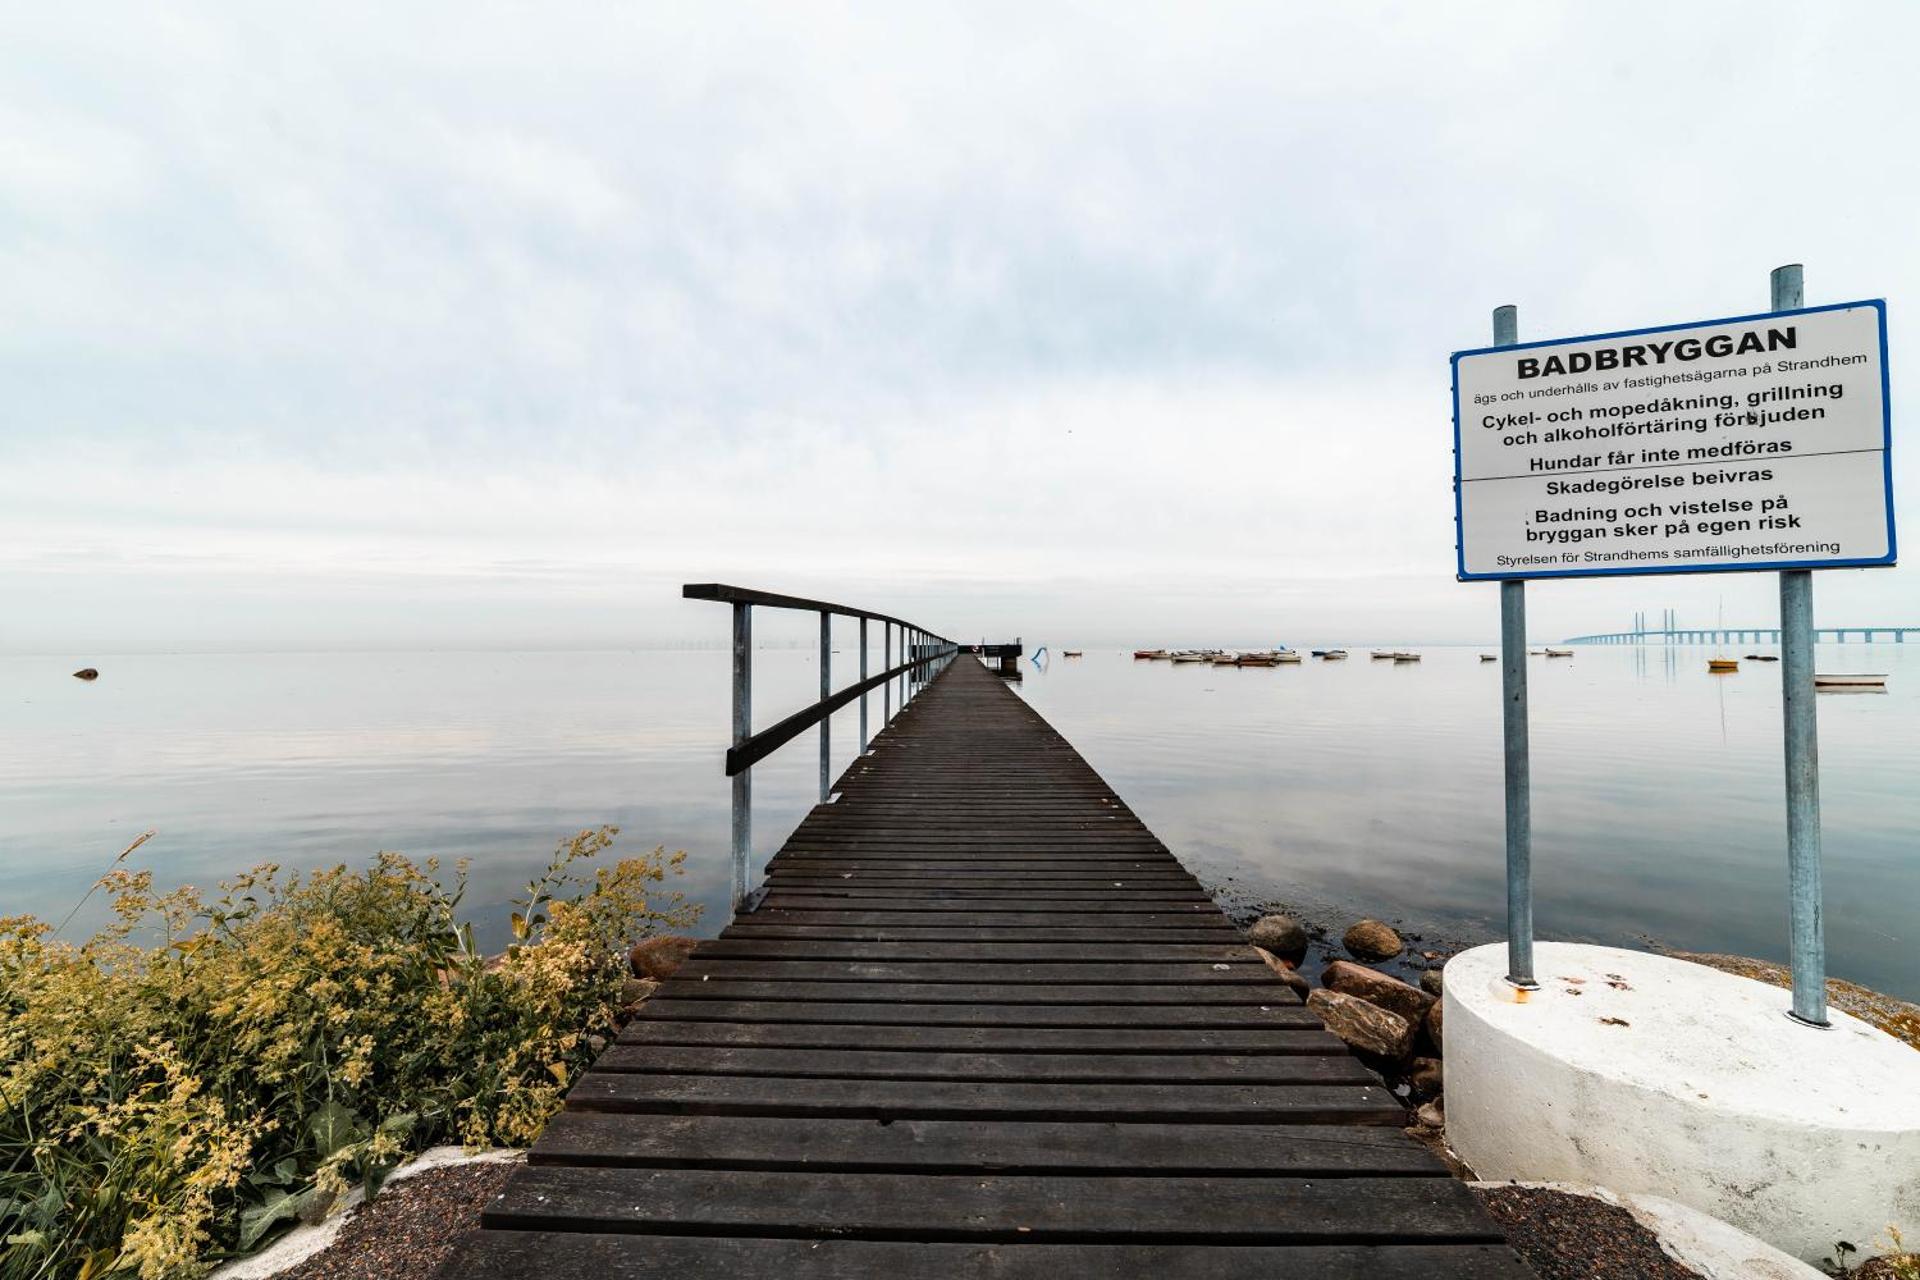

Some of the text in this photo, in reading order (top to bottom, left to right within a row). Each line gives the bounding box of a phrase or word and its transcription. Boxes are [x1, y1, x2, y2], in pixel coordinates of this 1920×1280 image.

[1517, 327, 1797, 379] BADBRYGGAN
[1474, 354, 1867, 406] ägs och underhålls av fastighetsägarna på Strandhem
[1482, 383, 1843, 430] Cykel- och mopedåkning, grillning
[1503, 406, 1825, 446] och alkoholförtäring förbjuden
[1530, 439, 1792, 471] Hundar får inte medföras
[1546, 469, 1773, 495] Skadegörelse beivras
[1535, 495, 1788, 523] Badning och vistelse på
[1526, 514, 1801, 544] bryggan sker på egen risk
[1497, 541, 1840, 567] Styrelsen för Strandhems samfällighetsförening
